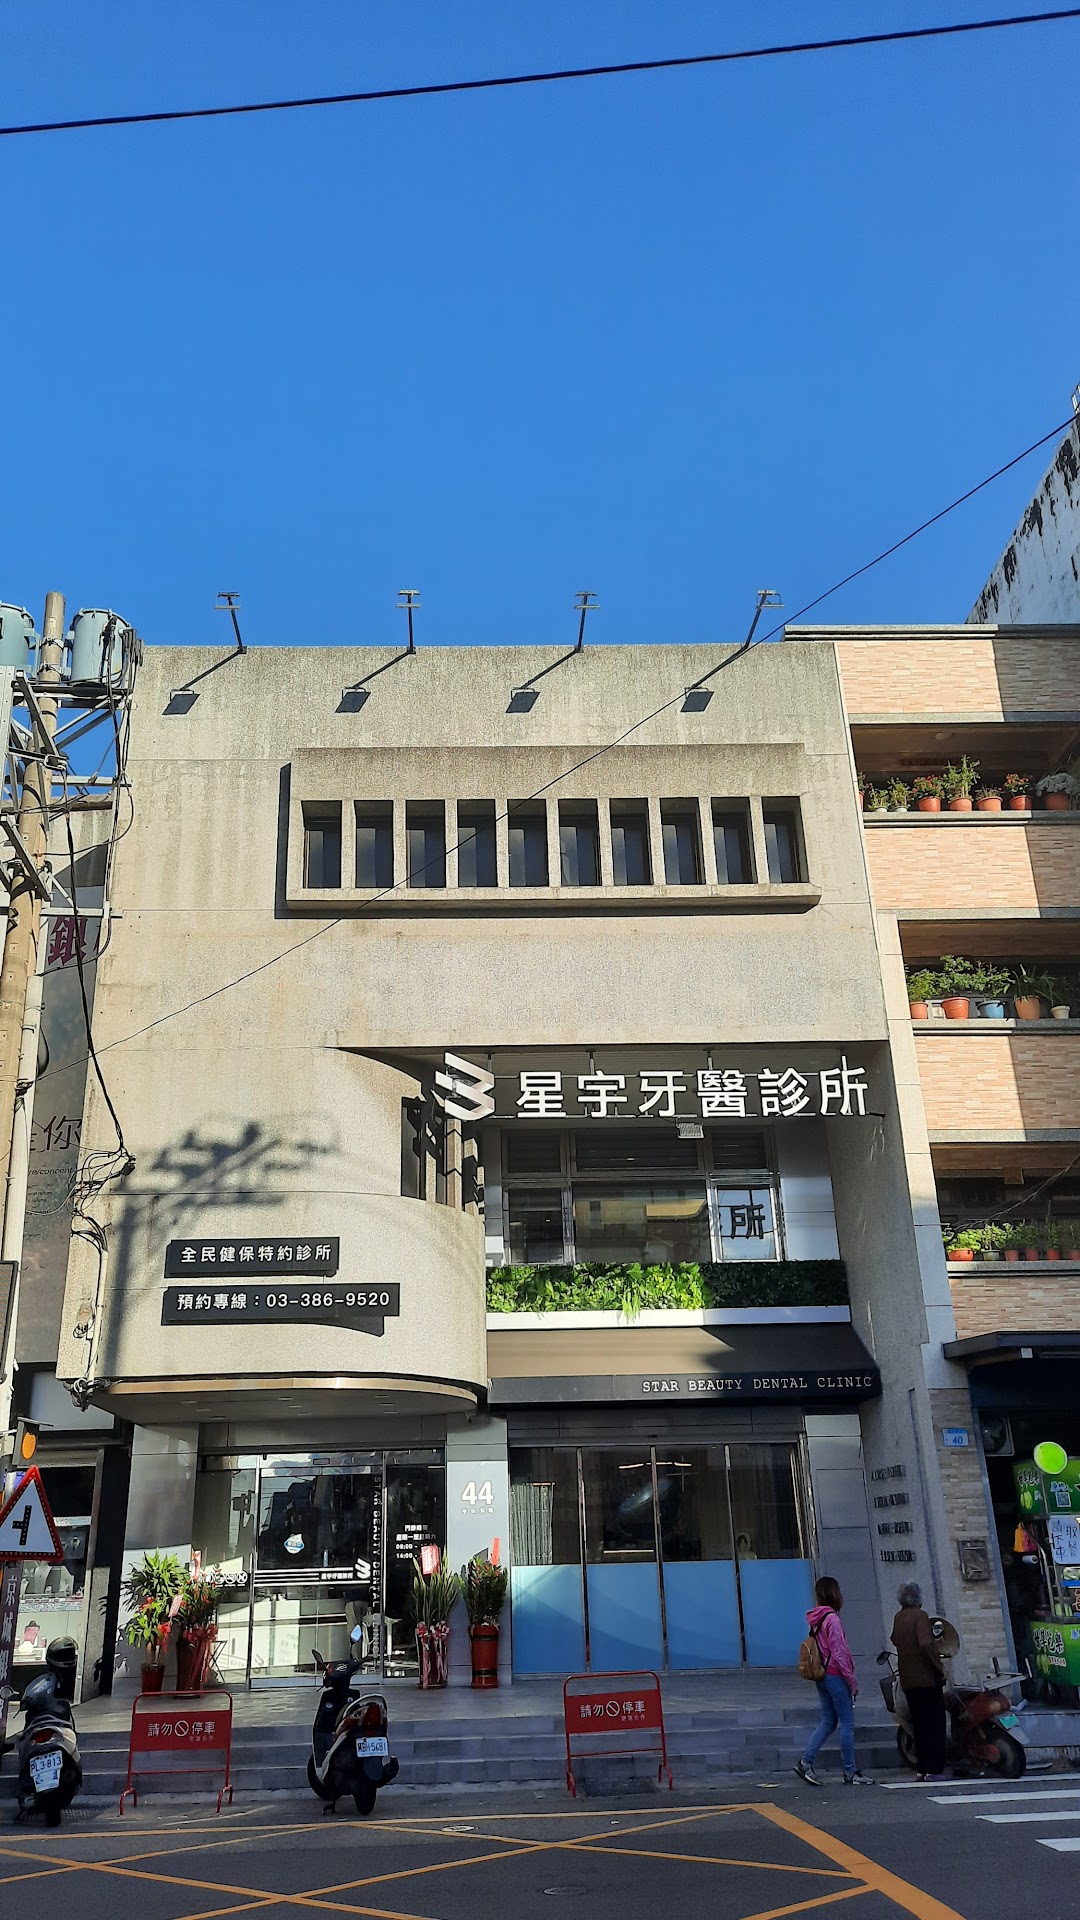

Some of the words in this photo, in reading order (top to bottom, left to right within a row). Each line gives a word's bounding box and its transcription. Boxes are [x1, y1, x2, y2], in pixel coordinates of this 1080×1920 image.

[515, 1067, 869, 1118] 星宇牙醫診所
[180, 1244, 332, 1263] 全民健保特約診所
[642, 1380, 680, 1392] STAR
[688, 1379, 743, 1391] BEAUTY
[753, 1378, 808, 1389] DENTAL
[817, 1376, 873, 1388] CLINIC
[952, 1435, 964, 1445] 40
[461, 1481, 494, 1505] 44
[373, 1510, 381, 1556] BEAUTY
[372, 1561, 380, 1608] DENTAL
